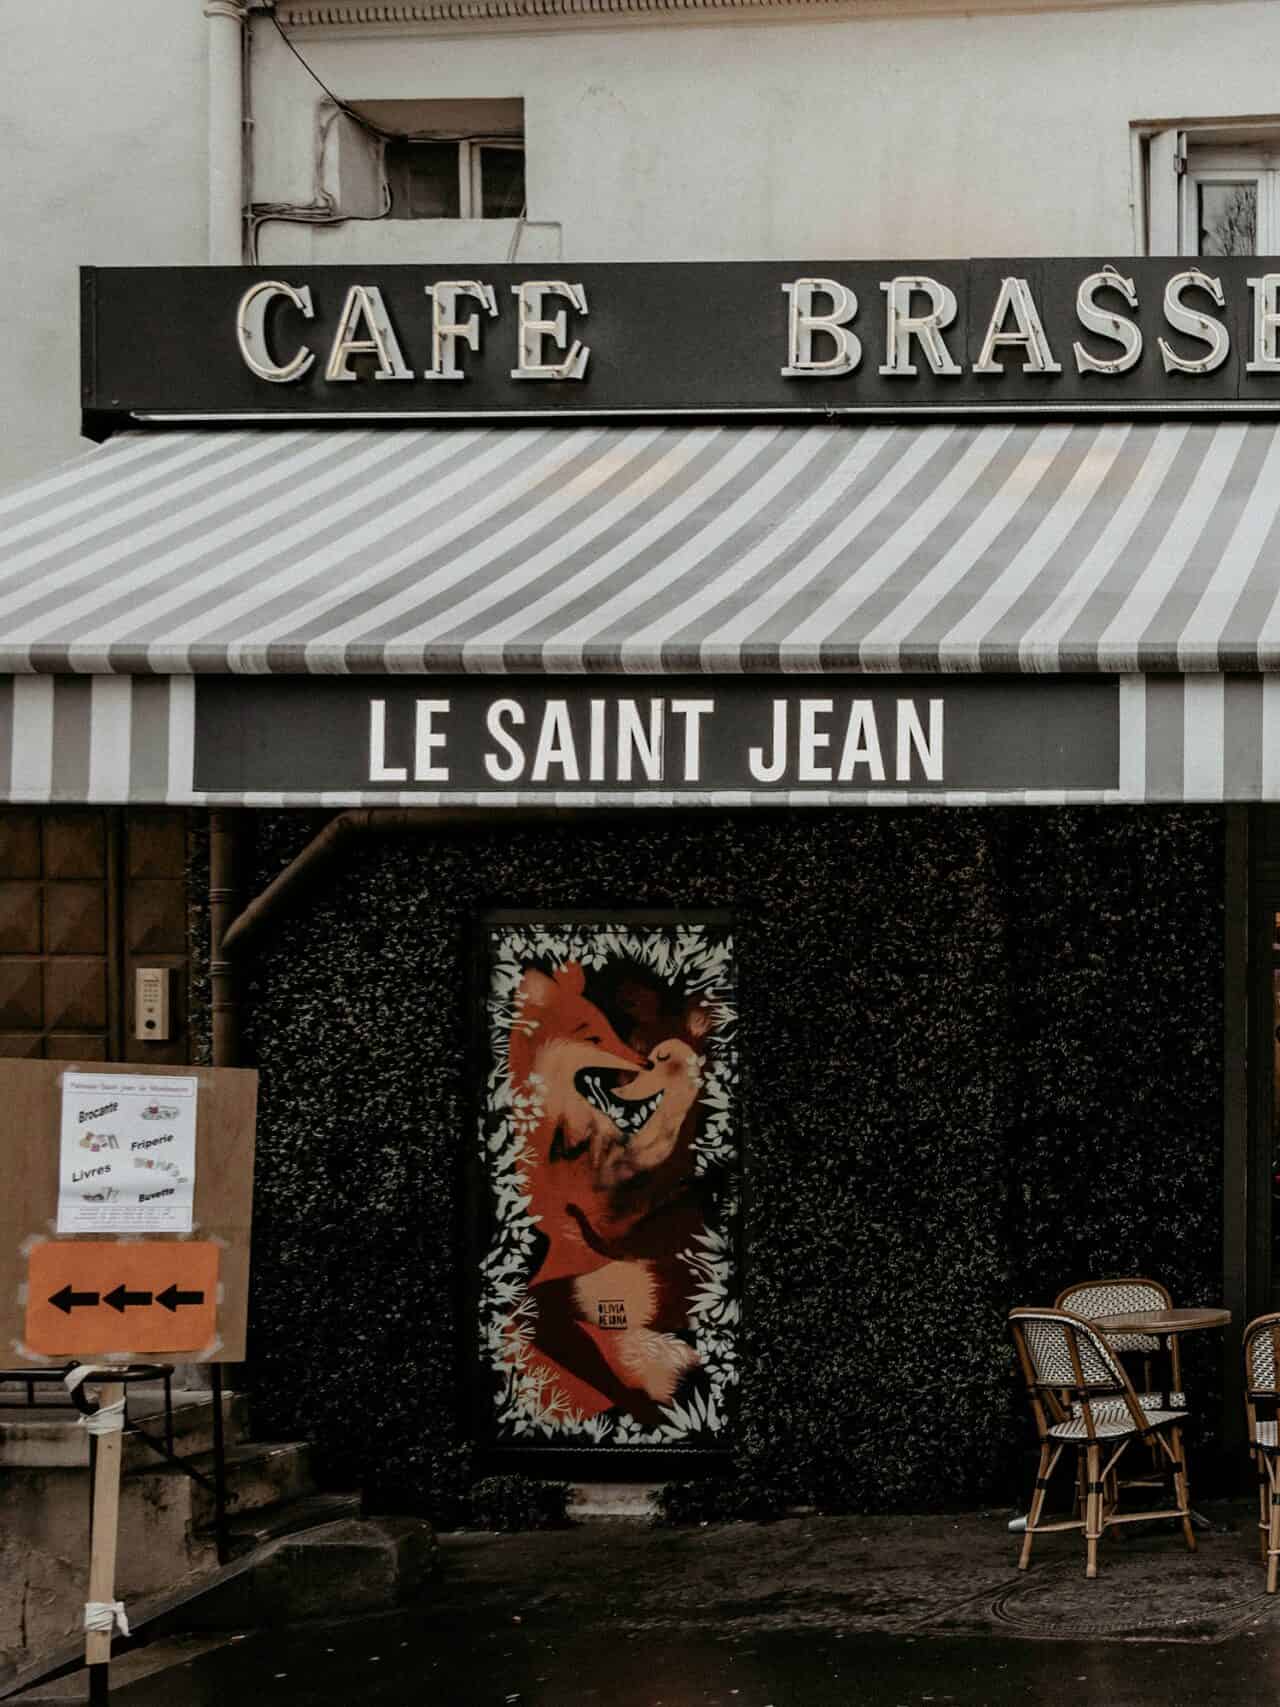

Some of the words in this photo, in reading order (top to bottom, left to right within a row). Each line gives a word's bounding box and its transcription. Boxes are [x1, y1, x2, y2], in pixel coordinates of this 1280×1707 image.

[237, 280, 590, 383] CAFE
[369, 698, 451, 783] LE
[483, 698, 715, 783] SAINT
[747, 697, 945, 783] JEAN
[130, 1133, 175, 1152] Friperie
[72, 1164, 112, 1183] Livres
